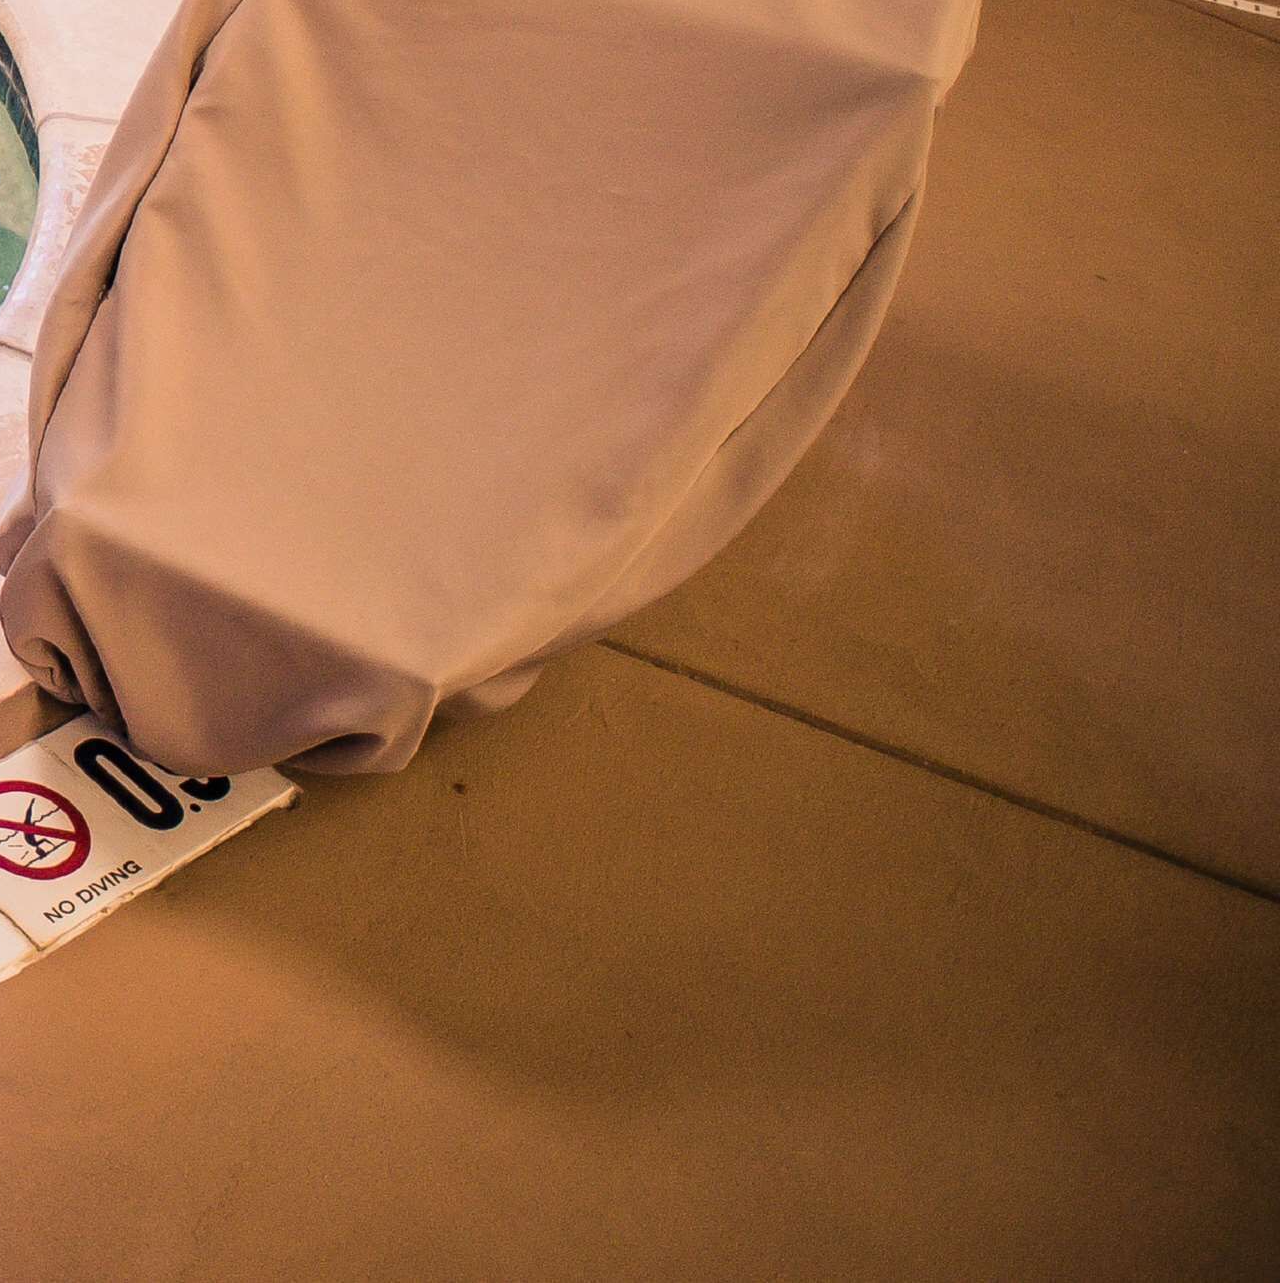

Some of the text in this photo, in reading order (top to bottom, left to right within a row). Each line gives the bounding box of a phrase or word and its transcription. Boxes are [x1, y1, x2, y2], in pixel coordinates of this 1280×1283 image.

[73, 738, 231, 831] 0.
[43, 860, 143, 923] NO DIVING
